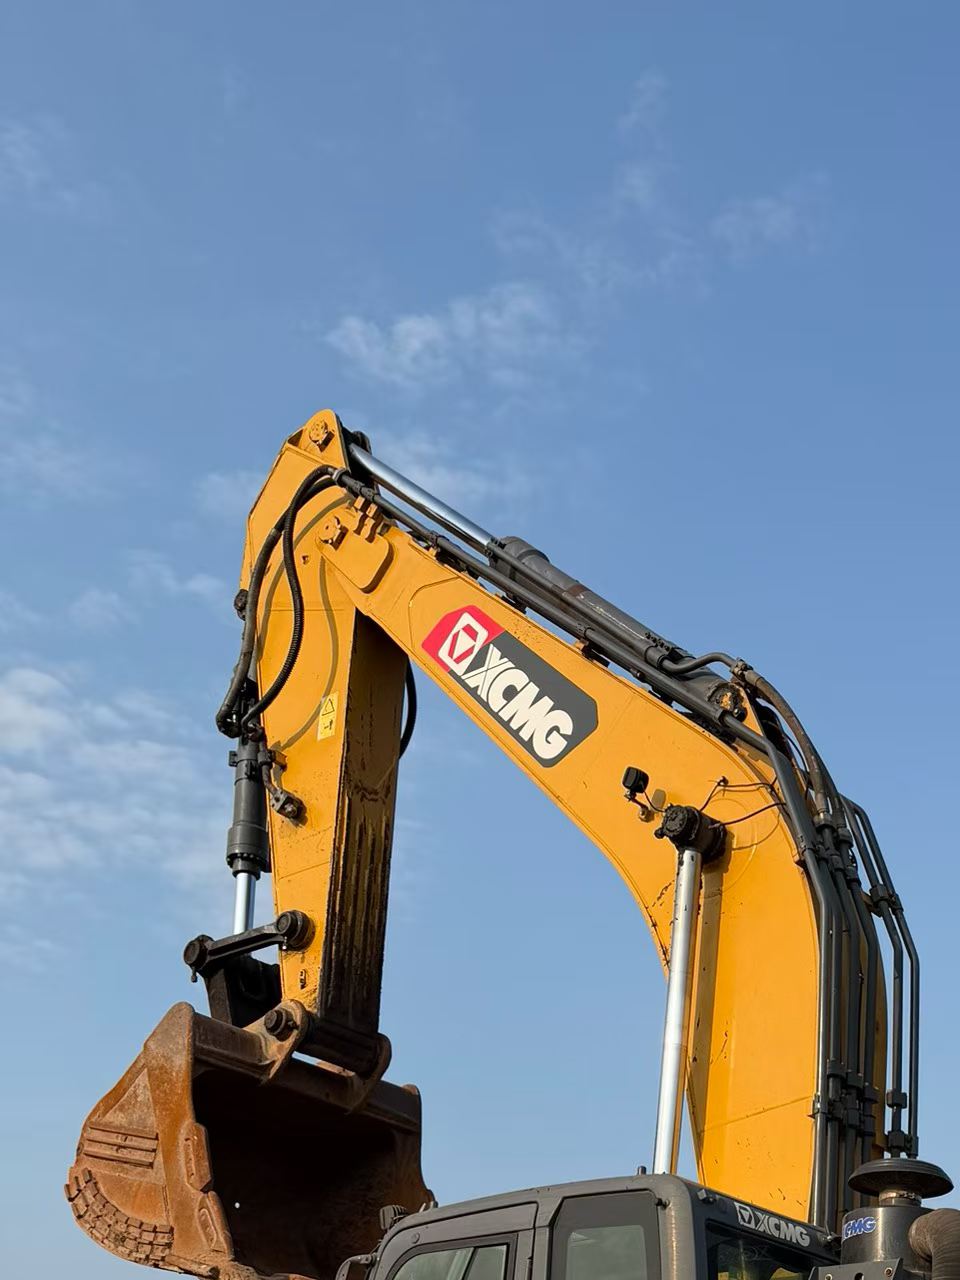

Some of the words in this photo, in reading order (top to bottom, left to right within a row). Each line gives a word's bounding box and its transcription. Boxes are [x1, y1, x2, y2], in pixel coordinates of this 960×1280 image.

[462, 643, 573, 759] XCMG
[756, 1212, 810, 1247] XCMG
[843, 1217, 876, 1239] CMG
